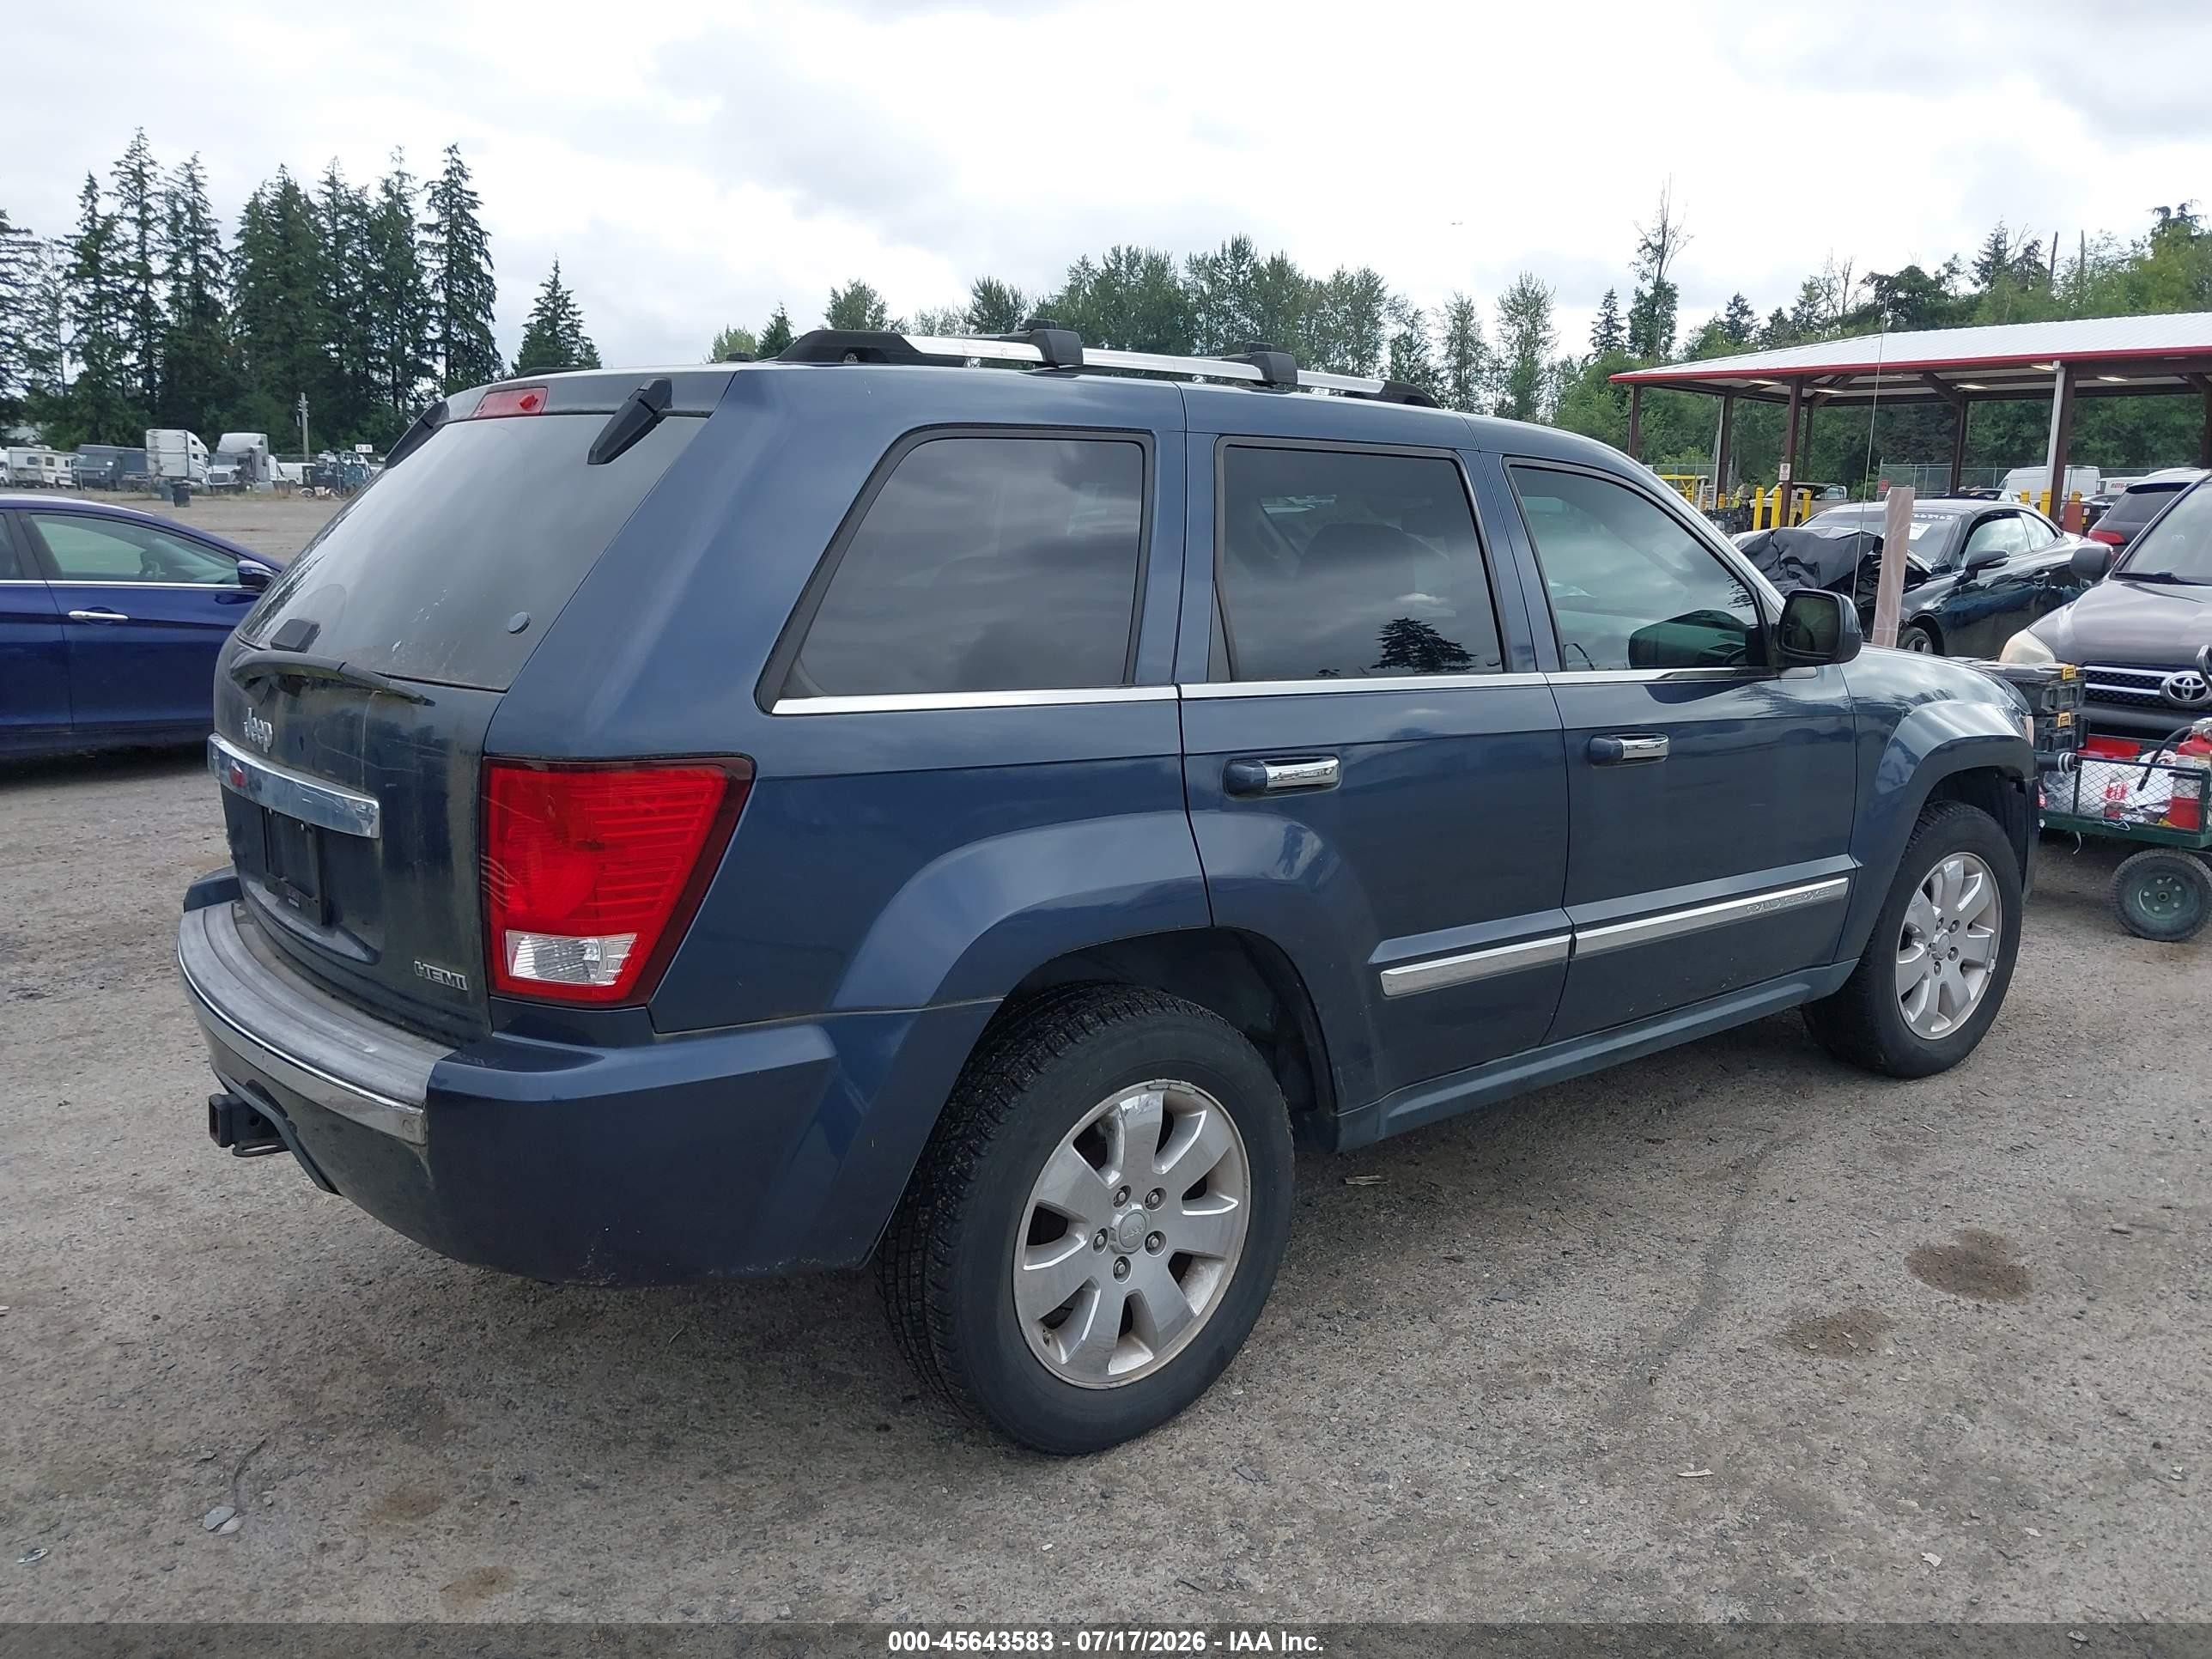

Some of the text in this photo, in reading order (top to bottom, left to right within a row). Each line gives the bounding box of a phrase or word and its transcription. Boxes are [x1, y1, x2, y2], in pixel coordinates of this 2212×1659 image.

[243, 707, 273, 754] Jeep
[1746, 899, 1781, 915] GRAND
[414, 960, 468, 991] HEMI
